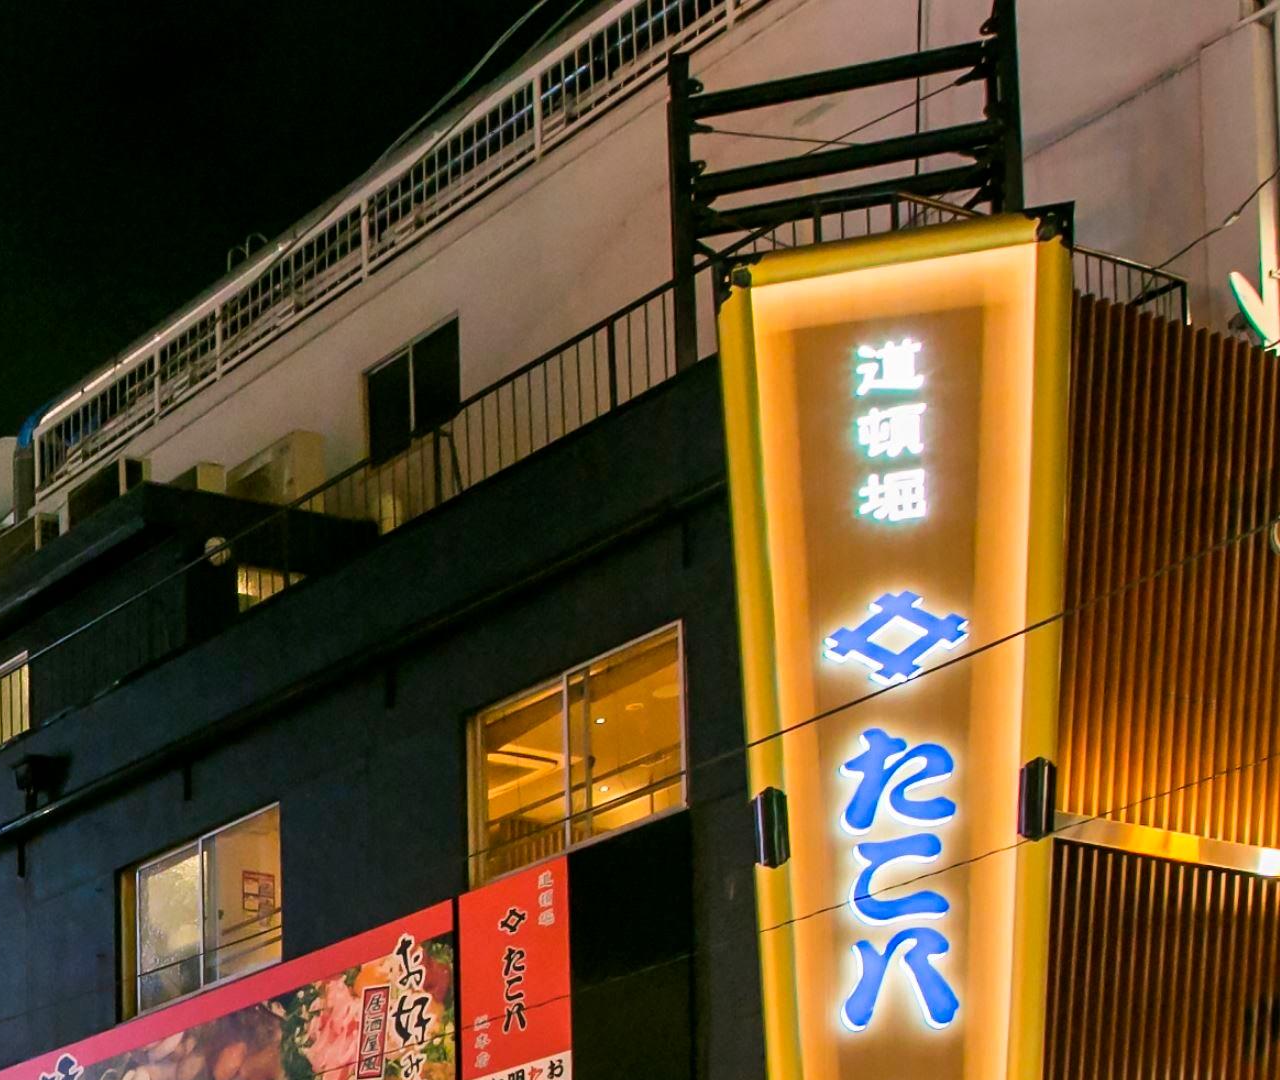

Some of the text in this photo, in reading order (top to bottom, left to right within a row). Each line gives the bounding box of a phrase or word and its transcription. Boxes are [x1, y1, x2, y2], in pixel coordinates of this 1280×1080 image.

[855, 338, 928, 522] 道頓堀
[839, 728, 960, 1033] たこ八
[503, 947, 527, 1034] たこ八
